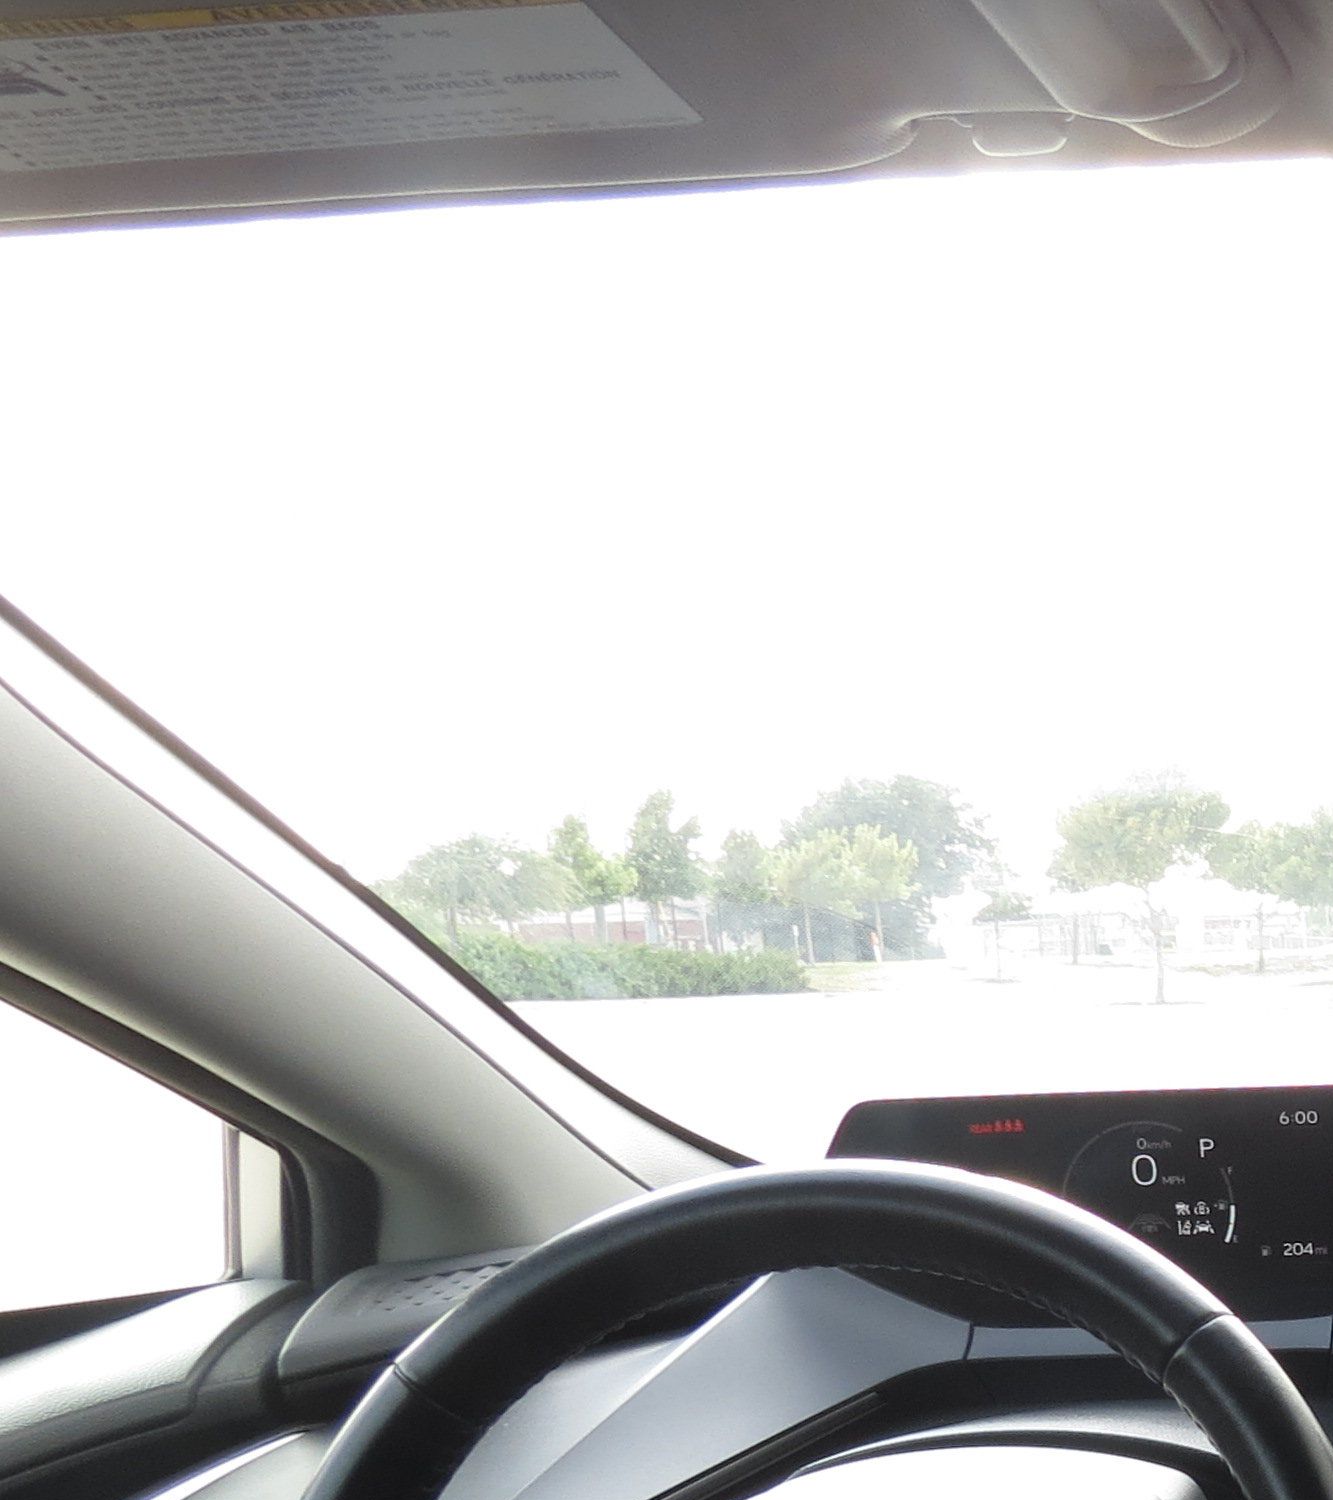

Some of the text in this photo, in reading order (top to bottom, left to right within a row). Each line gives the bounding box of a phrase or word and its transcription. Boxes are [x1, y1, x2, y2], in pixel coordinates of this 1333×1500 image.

[160, 25, 271, 42] ADVANCED
[1279, 1110, 1319, 1125] 6:00
[1199, 1138, 1214, 1158] P
[1131, 1154, 1185, 1186] 0 MPH
[1283, 1243, 1313, 1256] 204
